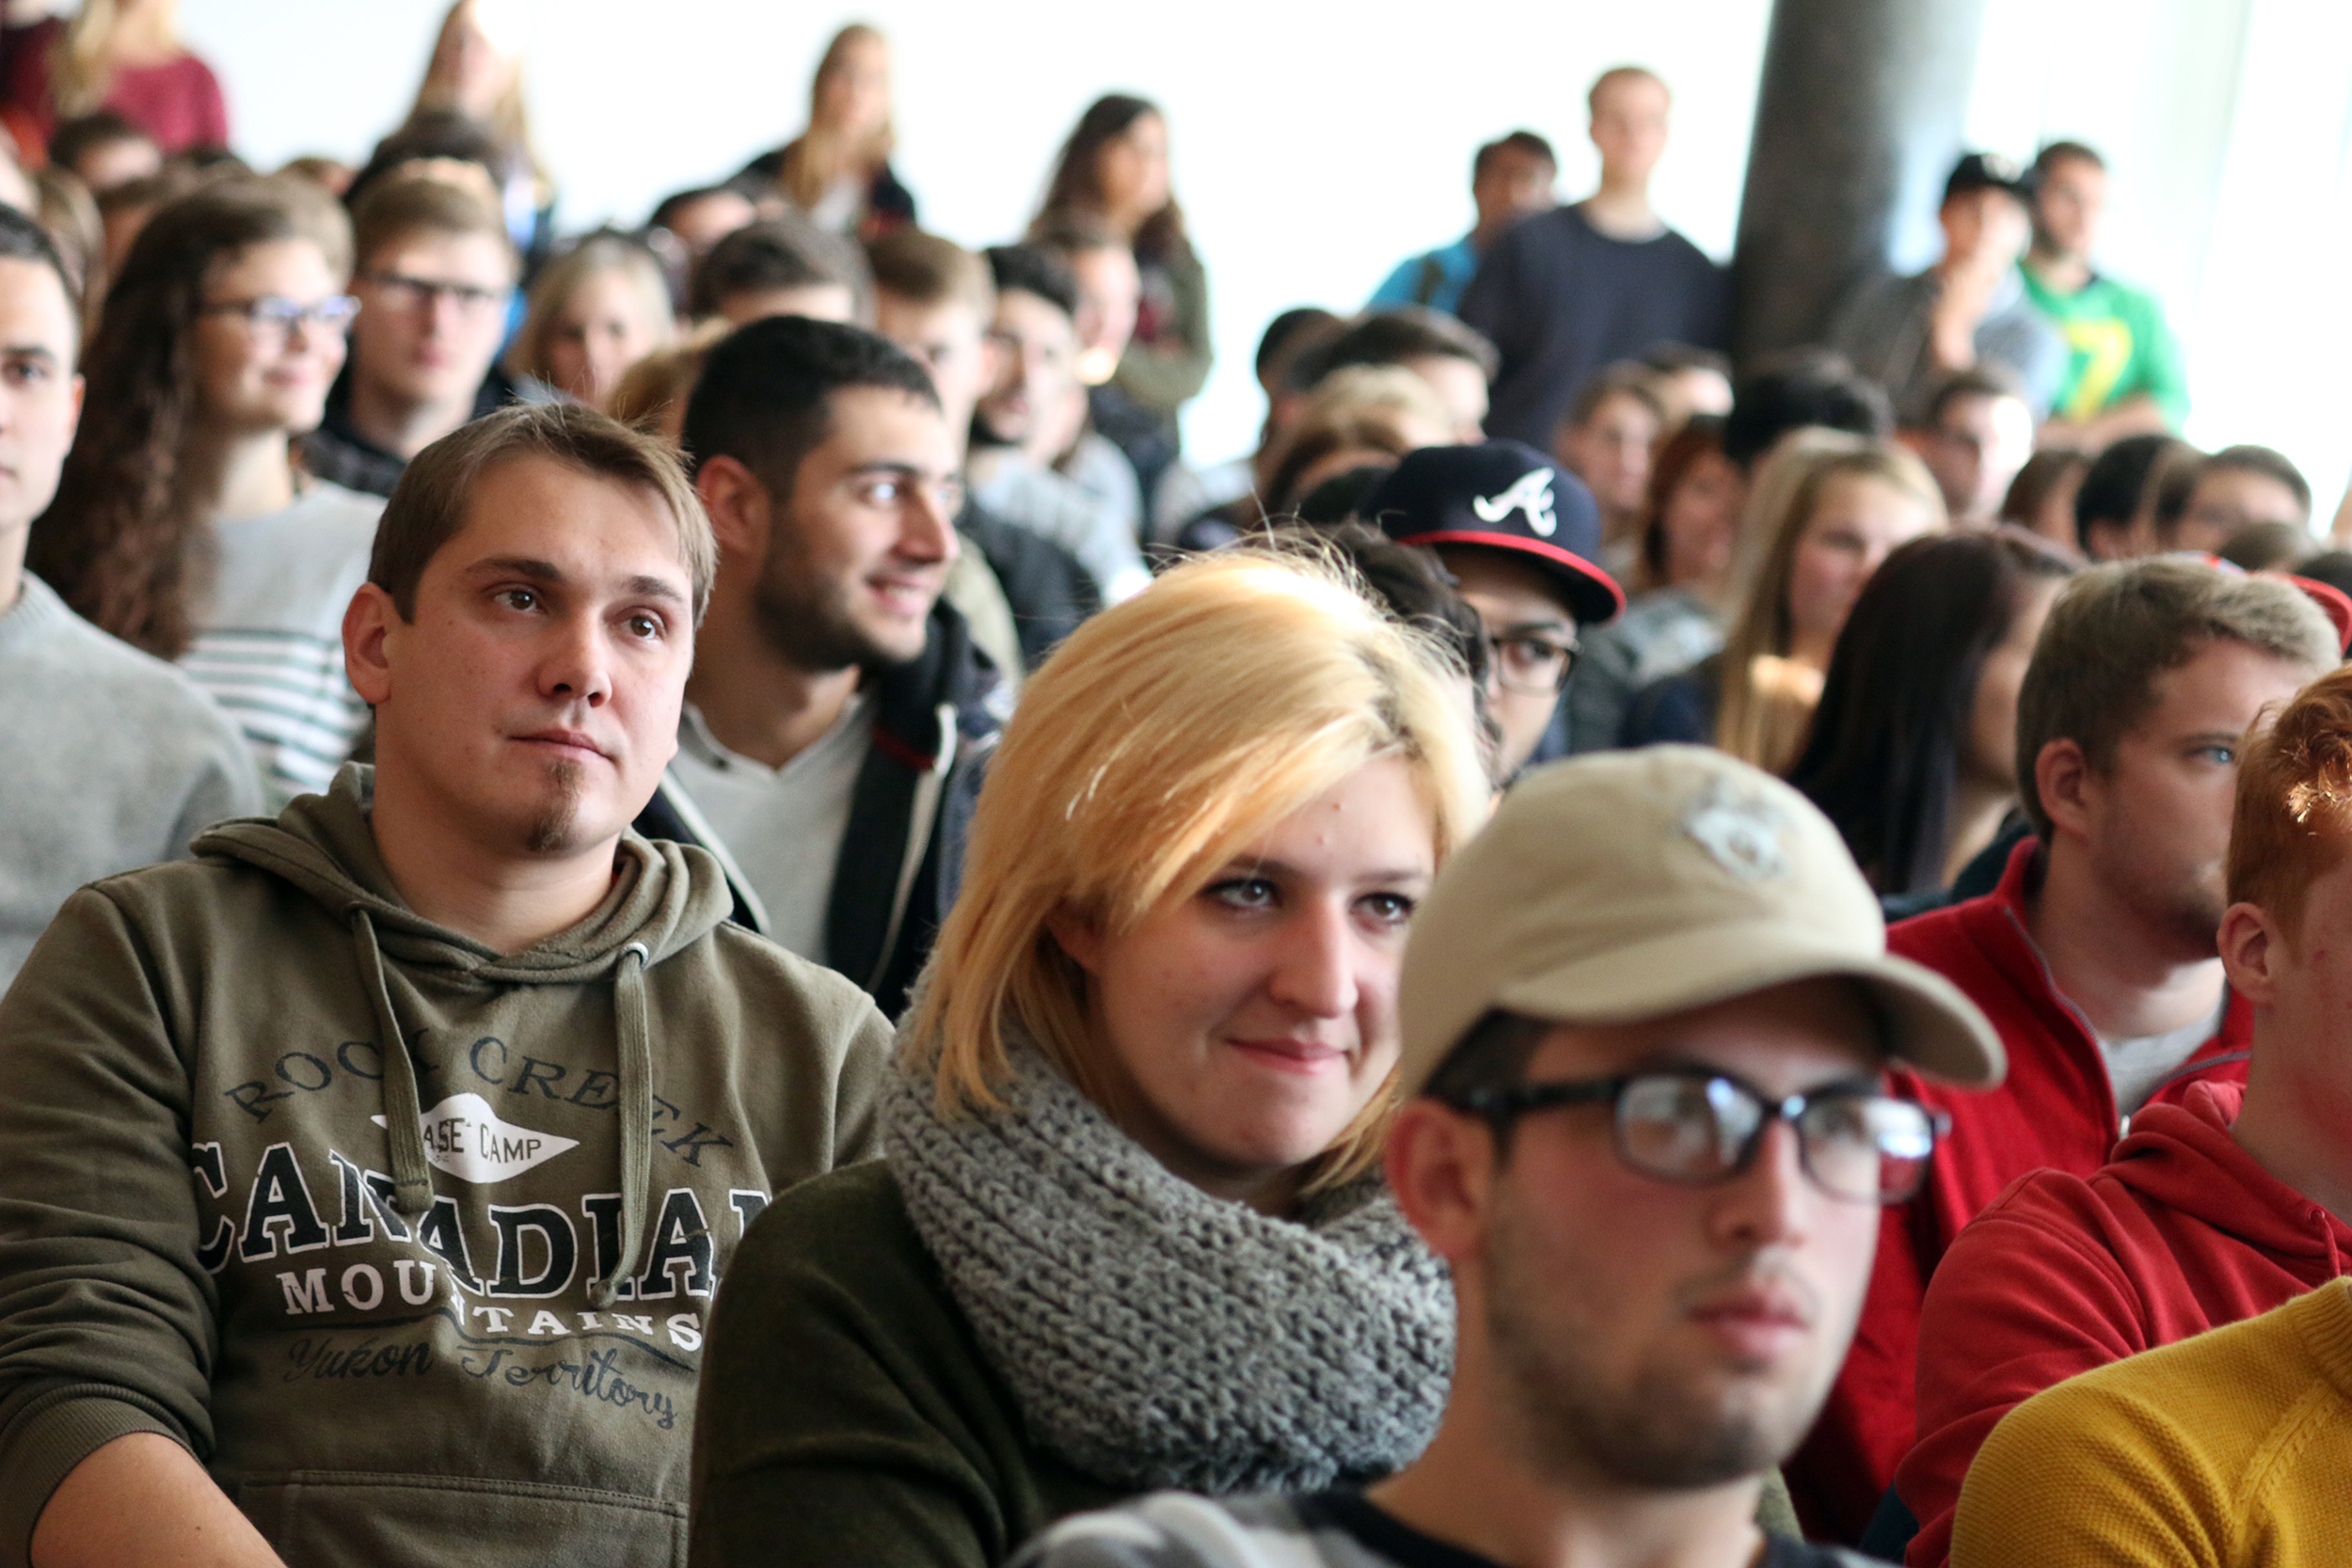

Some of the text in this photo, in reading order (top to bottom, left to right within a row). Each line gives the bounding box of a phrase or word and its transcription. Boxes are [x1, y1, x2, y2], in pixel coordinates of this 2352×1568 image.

[2063, 320, 2133, 423] 7
[1473, 467, 1557, 537] A
[423, 1117, 542, 1164] ASE CAMP
[276, 1259, 703, 1352] MOUTAINS
[283, 1337, 679, 1431] Yukon Territory
